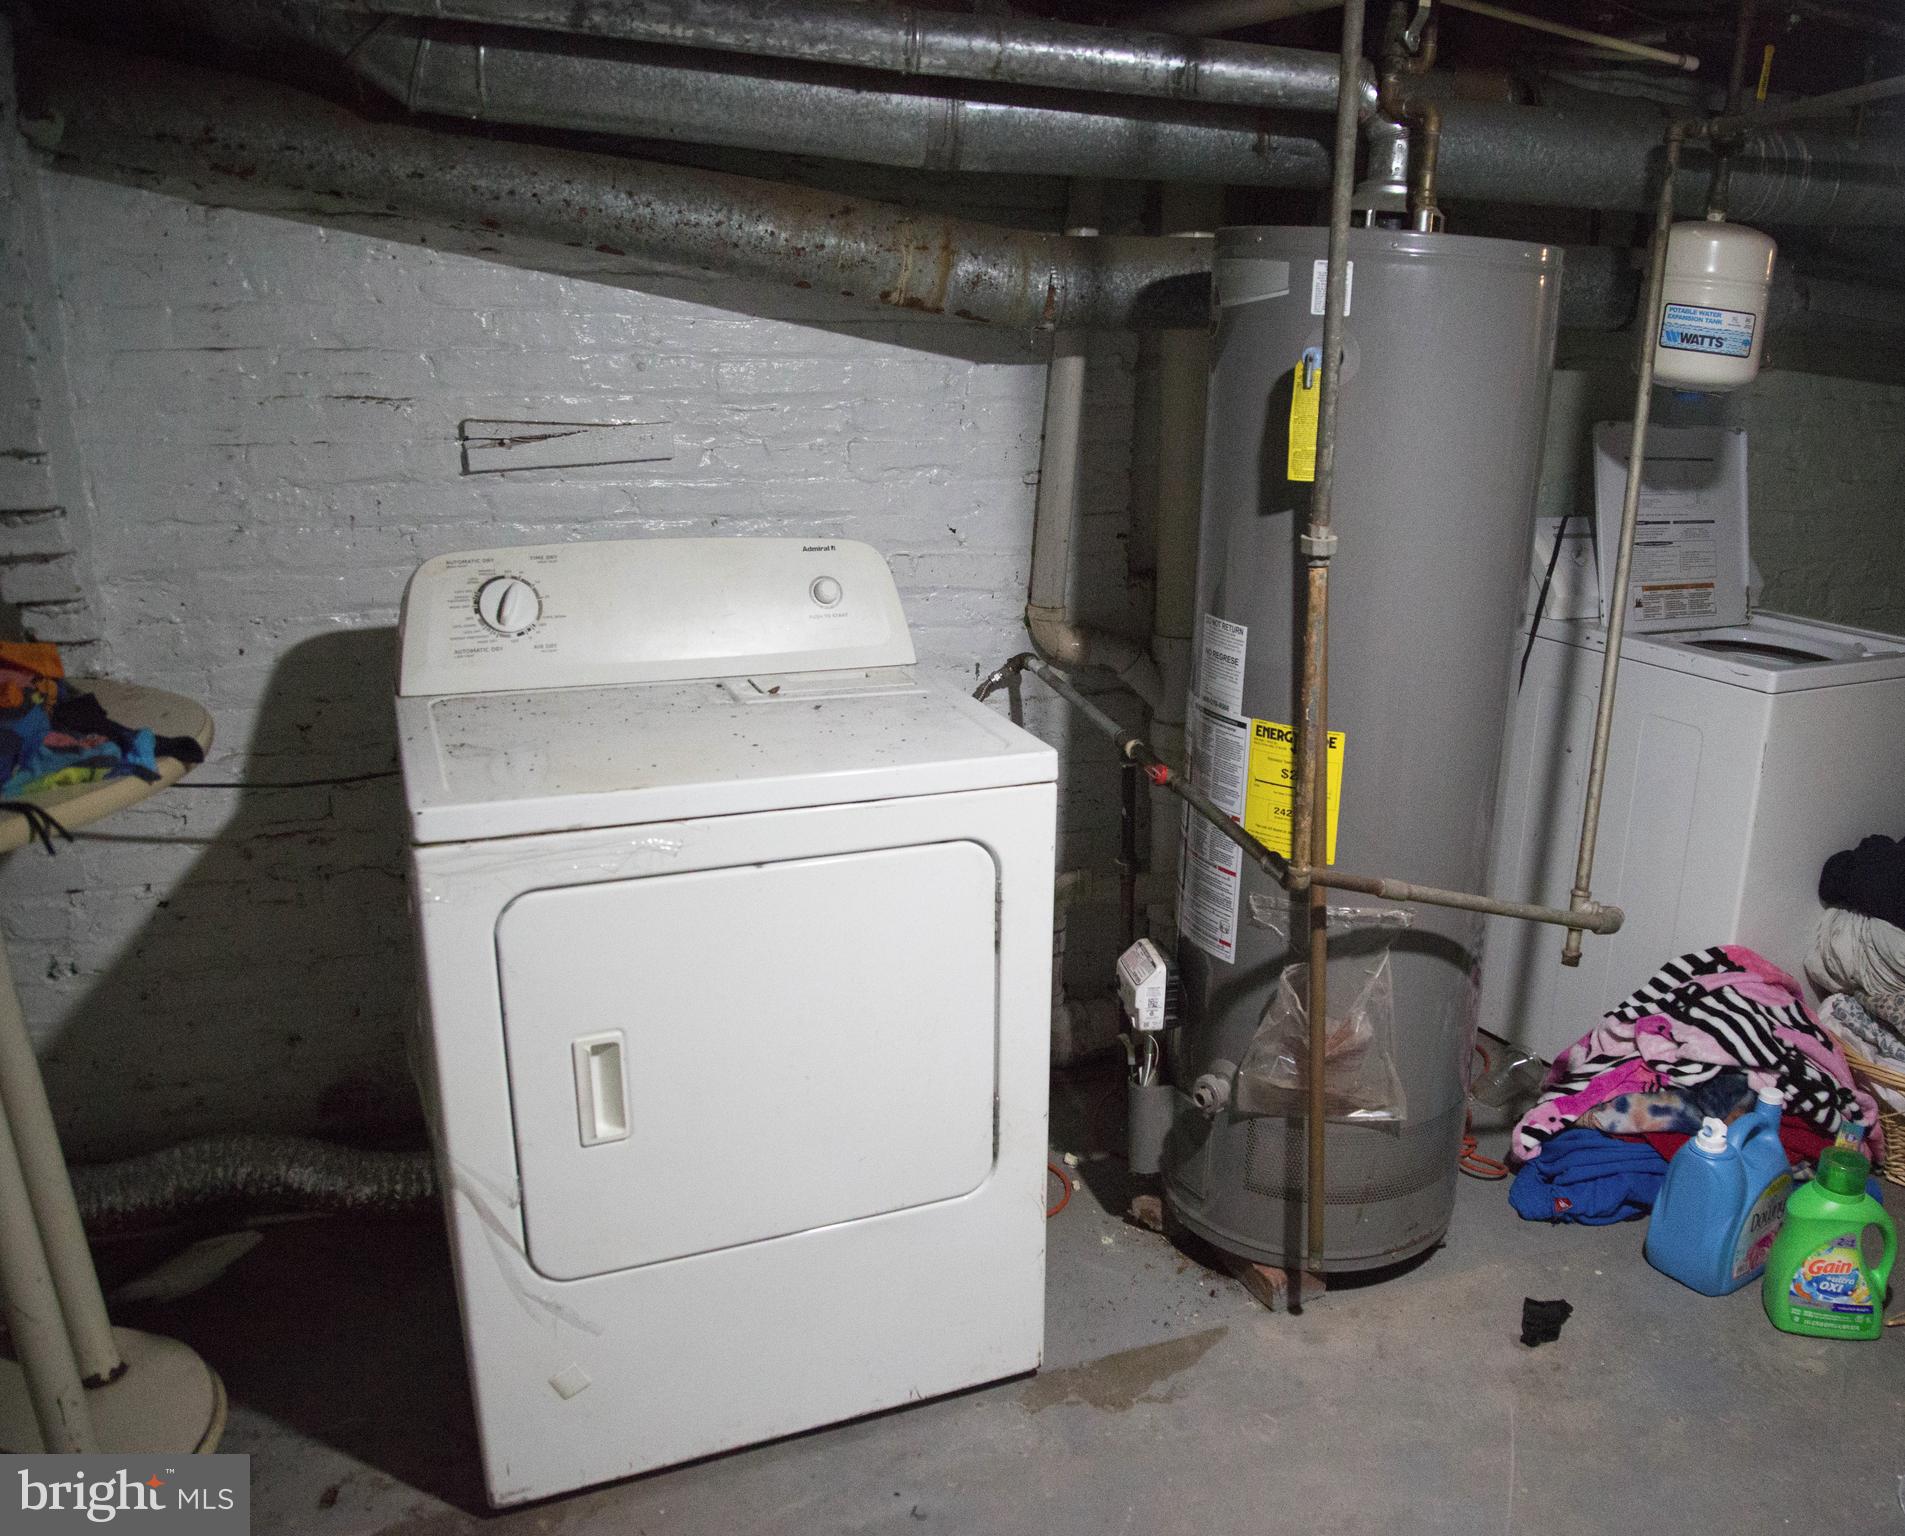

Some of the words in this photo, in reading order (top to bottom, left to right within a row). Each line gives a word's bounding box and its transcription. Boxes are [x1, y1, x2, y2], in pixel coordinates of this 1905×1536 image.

[1668, 306, 1697, 316] POTABLE
[1698, 309, 1722, 319] WATER
[1667, 313, 1705, 323] EXPANSION
[1705, 318, 1723, 326] TANK
[1680, 331, 1724, 348] WATTS
[802, 544, 831, 552] Admiral
[1222, 622, 1244, 636] RETURN
[454, 647, 490, 655] AUTOMATIC
[1807, 1259, 1853, 1276] Gain
